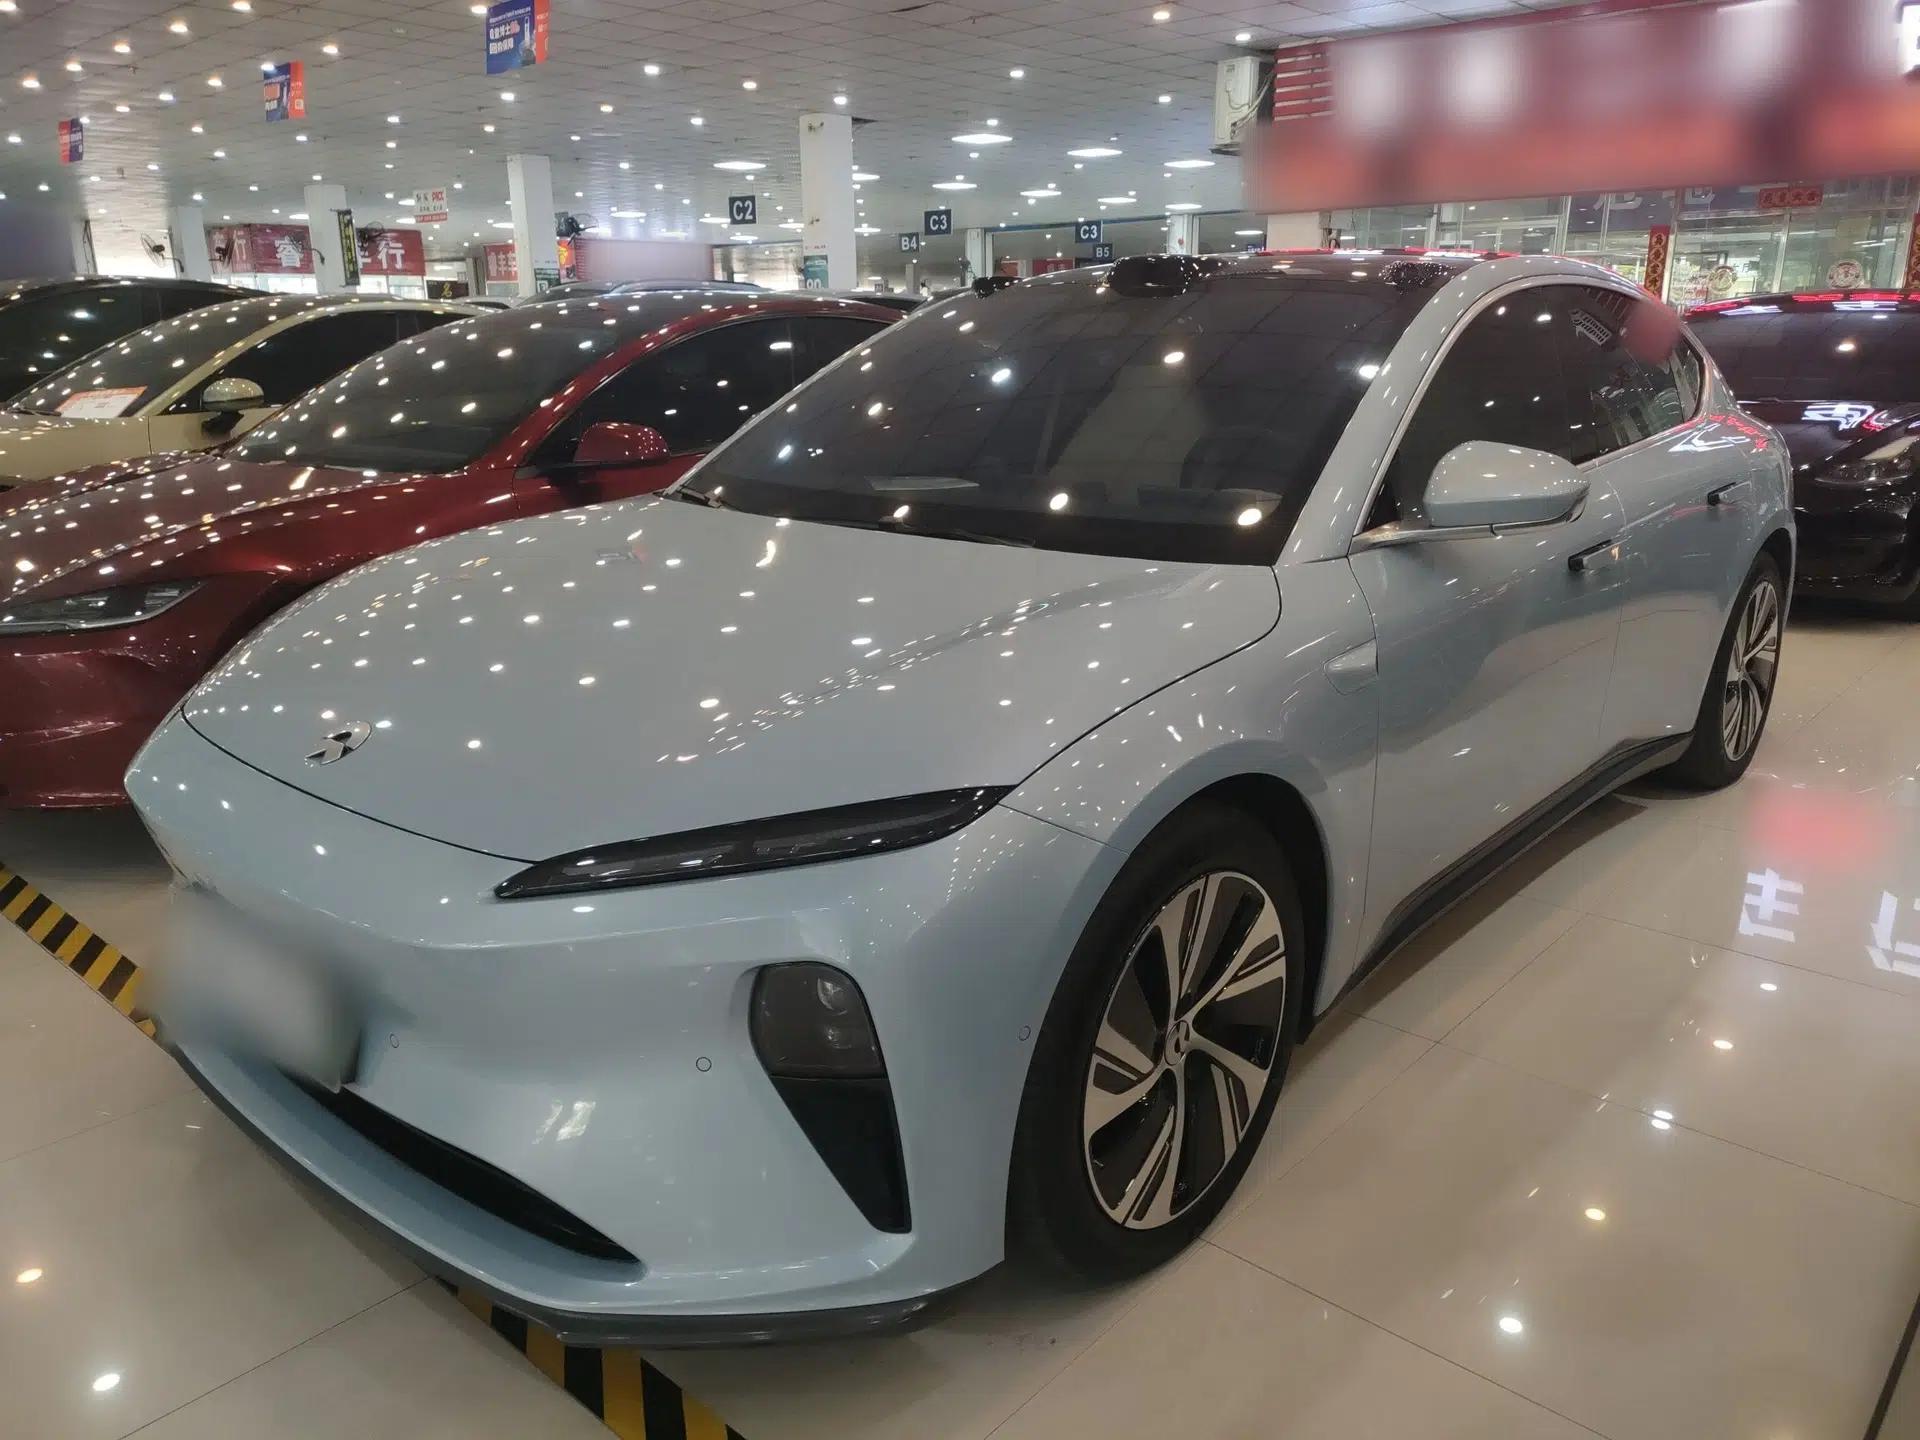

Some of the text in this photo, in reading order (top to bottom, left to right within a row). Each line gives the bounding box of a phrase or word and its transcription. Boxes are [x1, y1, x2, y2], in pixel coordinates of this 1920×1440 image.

[733, 200, 753, 220] C2
[929, 214, 948, 230] C3
[1080, 225, 1098, 239] C3
[901, 236, 917, 251] B4
[1096, 247, 1110, 258] B5
